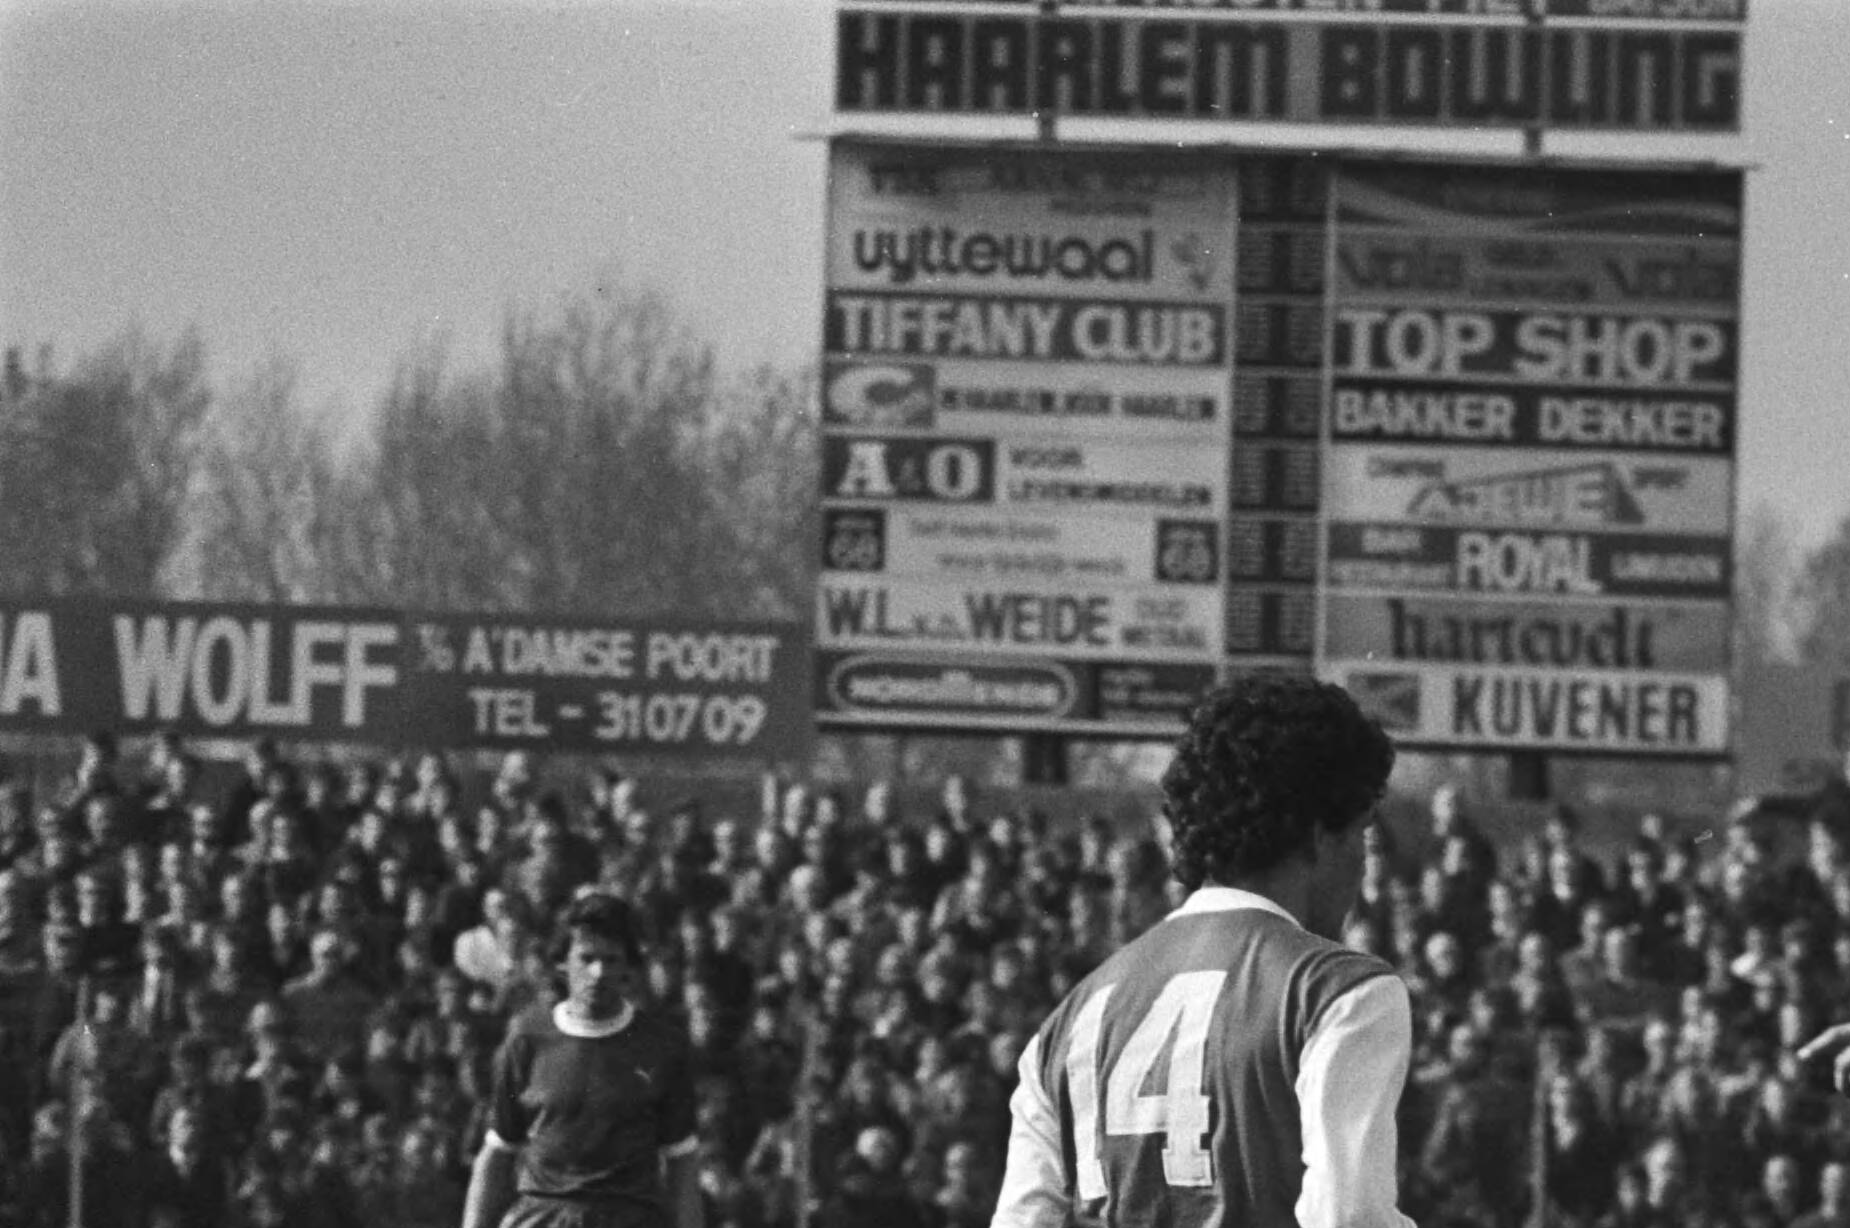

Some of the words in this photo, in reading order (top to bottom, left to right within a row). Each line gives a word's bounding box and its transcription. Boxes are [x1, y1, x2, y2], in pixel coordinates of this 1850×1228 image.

[837, 14, 1290, 119] HAARLEM
[1321, 25, 1740, 129] BOWLING
[853, 227, 1154, 282] uyttewaal
[832, 301, 1061, 356] TIFFANY
[1071, 307, 1217, 360] CLUB
[1338, 310, 1496, 377] TOP
[1514, 315, 1726, 384] SHOP
[1336, 390, 1515, 438] BAKKER
[1537, 399, 1725, 447] DEKKER
[1457, 532, 1603, 594] ROYAL
[965, 591, 1112, 646] WEIDE
[112, 614, 399, 727] WOLFF
[646, 631, 782, 682] POORT
[1451, 673, 1699, 743] KUVENER
